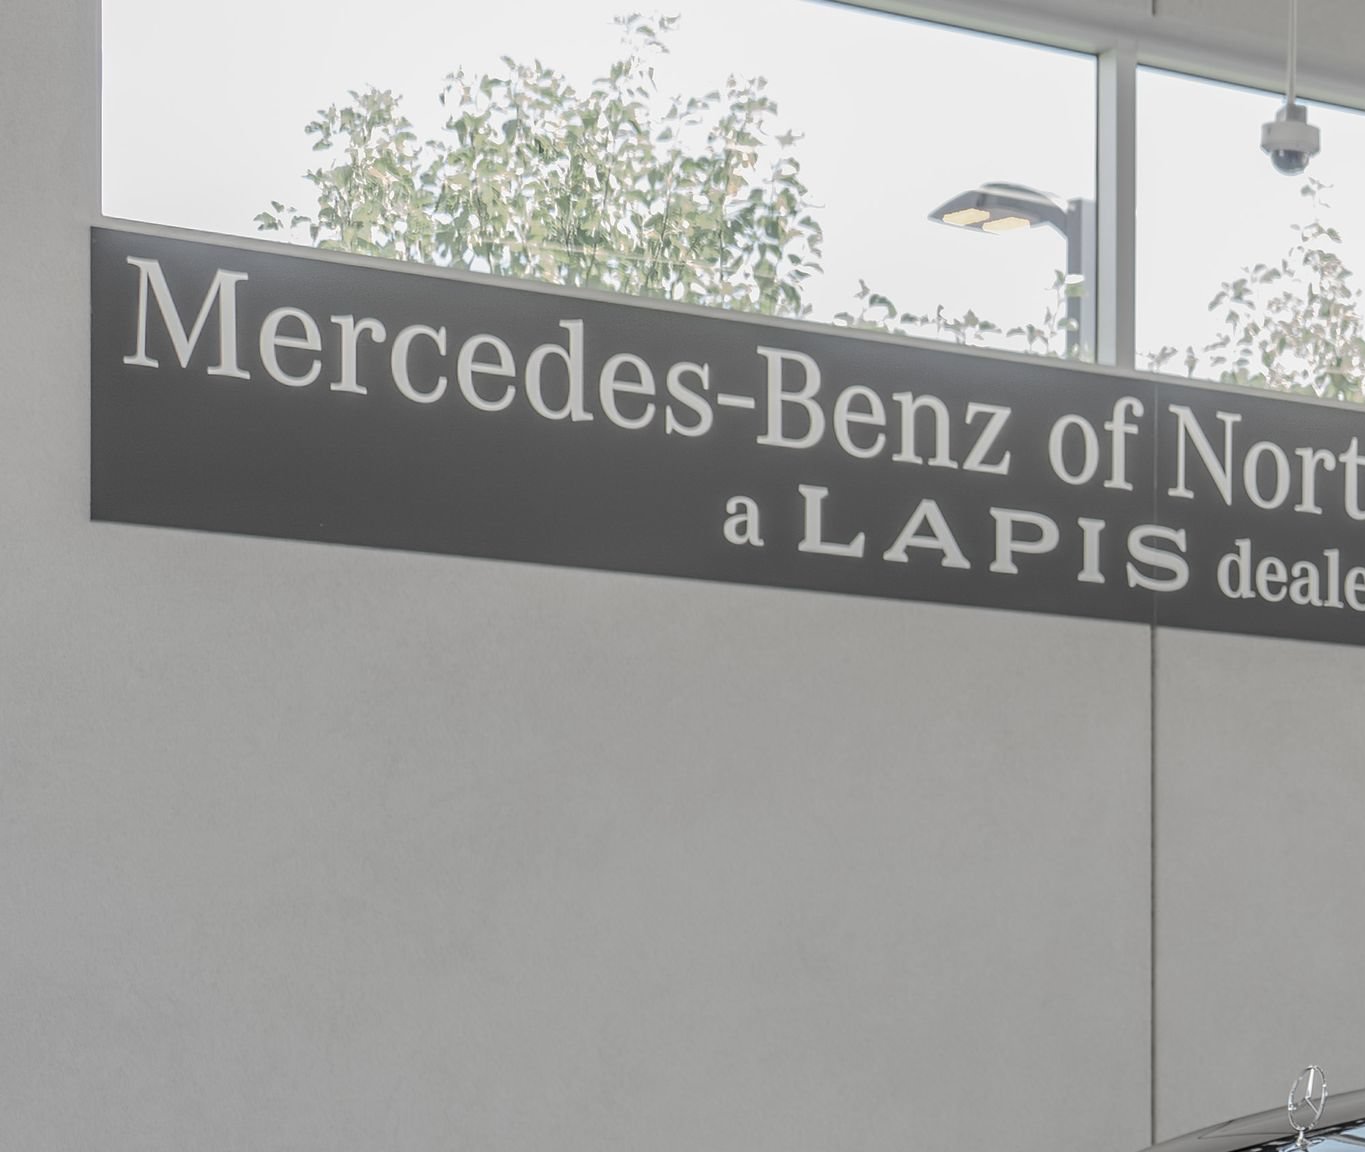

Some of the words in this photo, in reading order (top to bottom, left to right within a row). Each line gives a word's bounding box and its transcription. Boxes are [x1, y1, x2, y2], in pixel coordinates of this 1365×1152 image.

[122, 255, 1013, 476] Mercedes-Benz
[1048, 395, 1145, 492] of
[723, 495, 766, 548] a
[797, 483, 1191, 592] LAPIS
